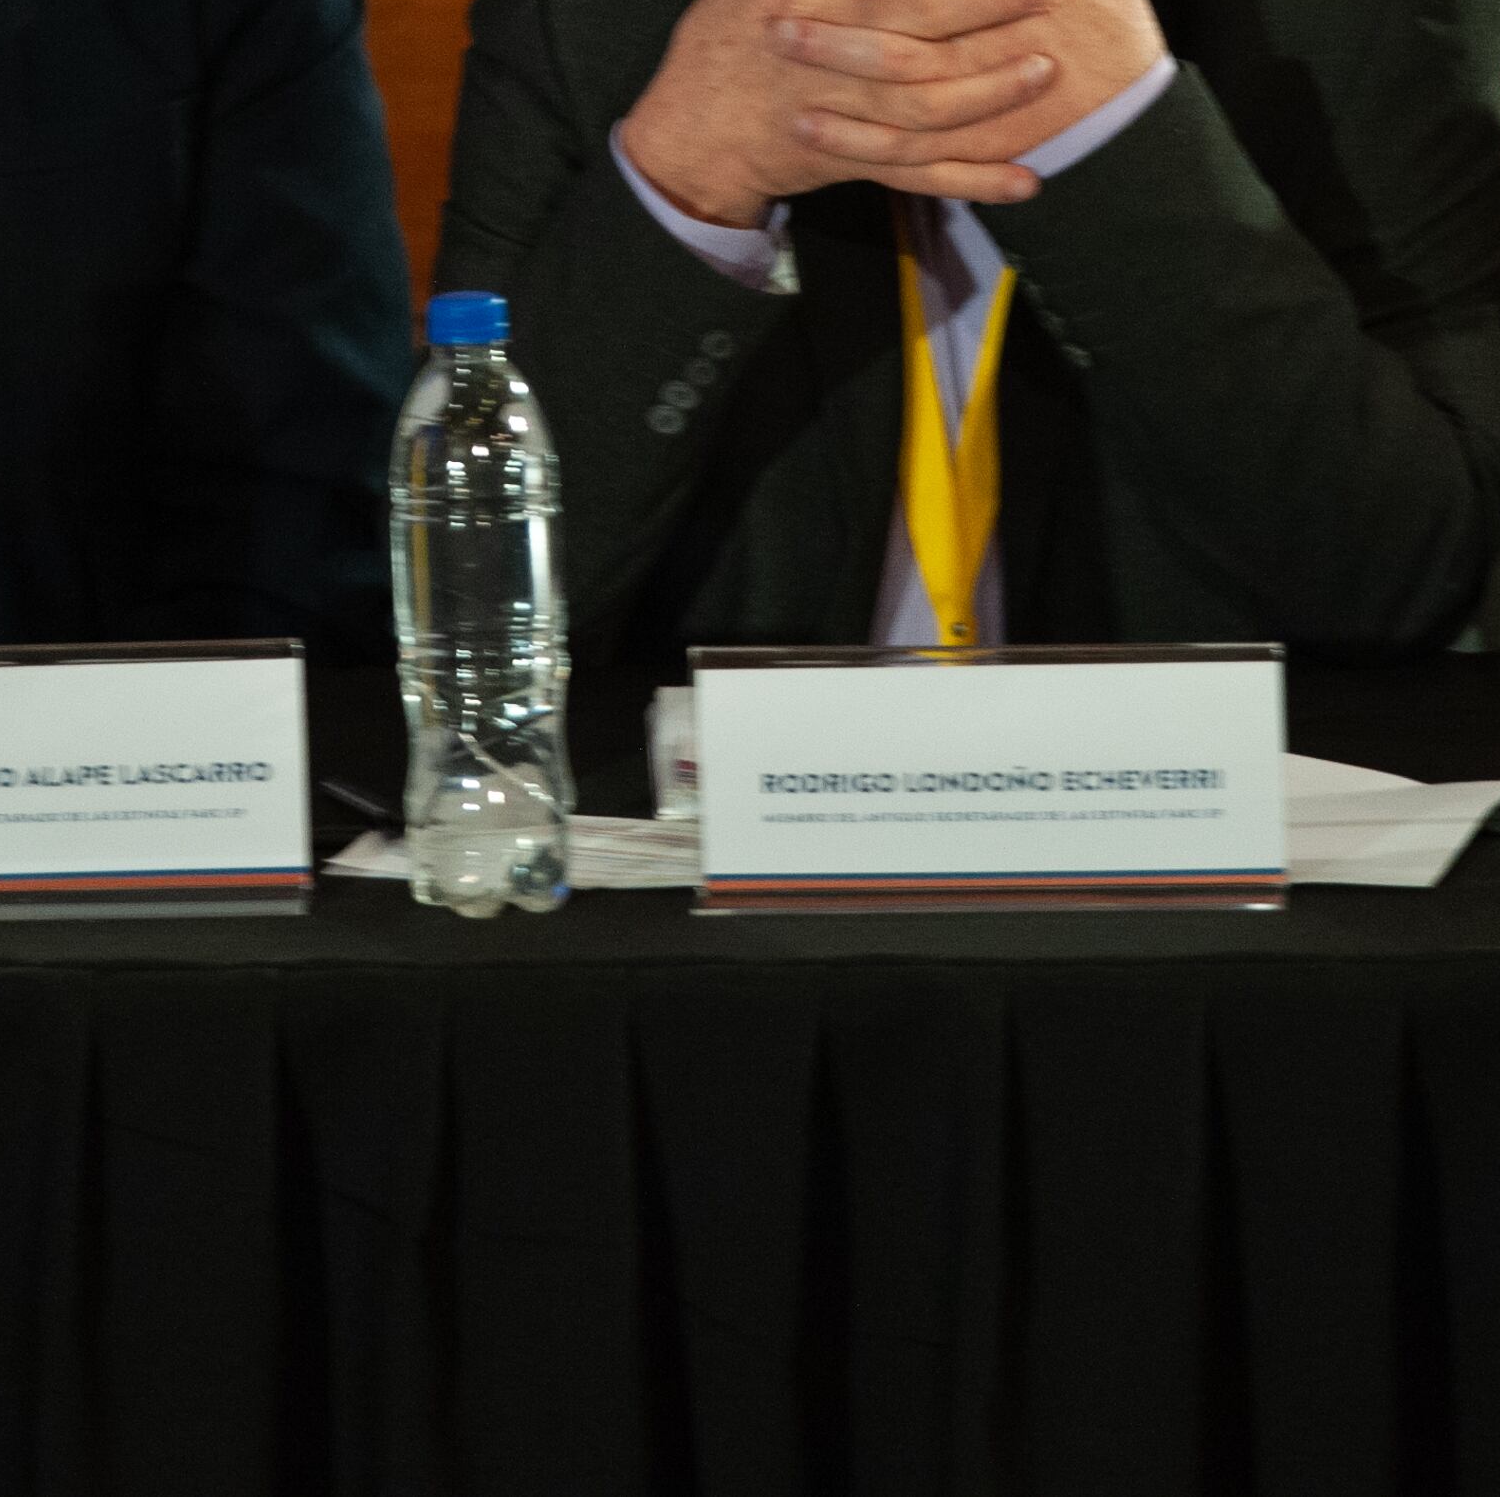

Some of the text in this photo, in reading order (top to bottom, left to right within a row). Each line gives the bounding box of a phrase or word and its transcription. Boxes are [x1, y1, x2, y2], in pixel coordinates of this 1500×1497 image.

[24, 763, 113, 788] ALAPE
[117, 760, 274, 785] LASCARRO
[760, 765, 1226, 794] RODRIGO LONDOÑO ECHEVERRI
